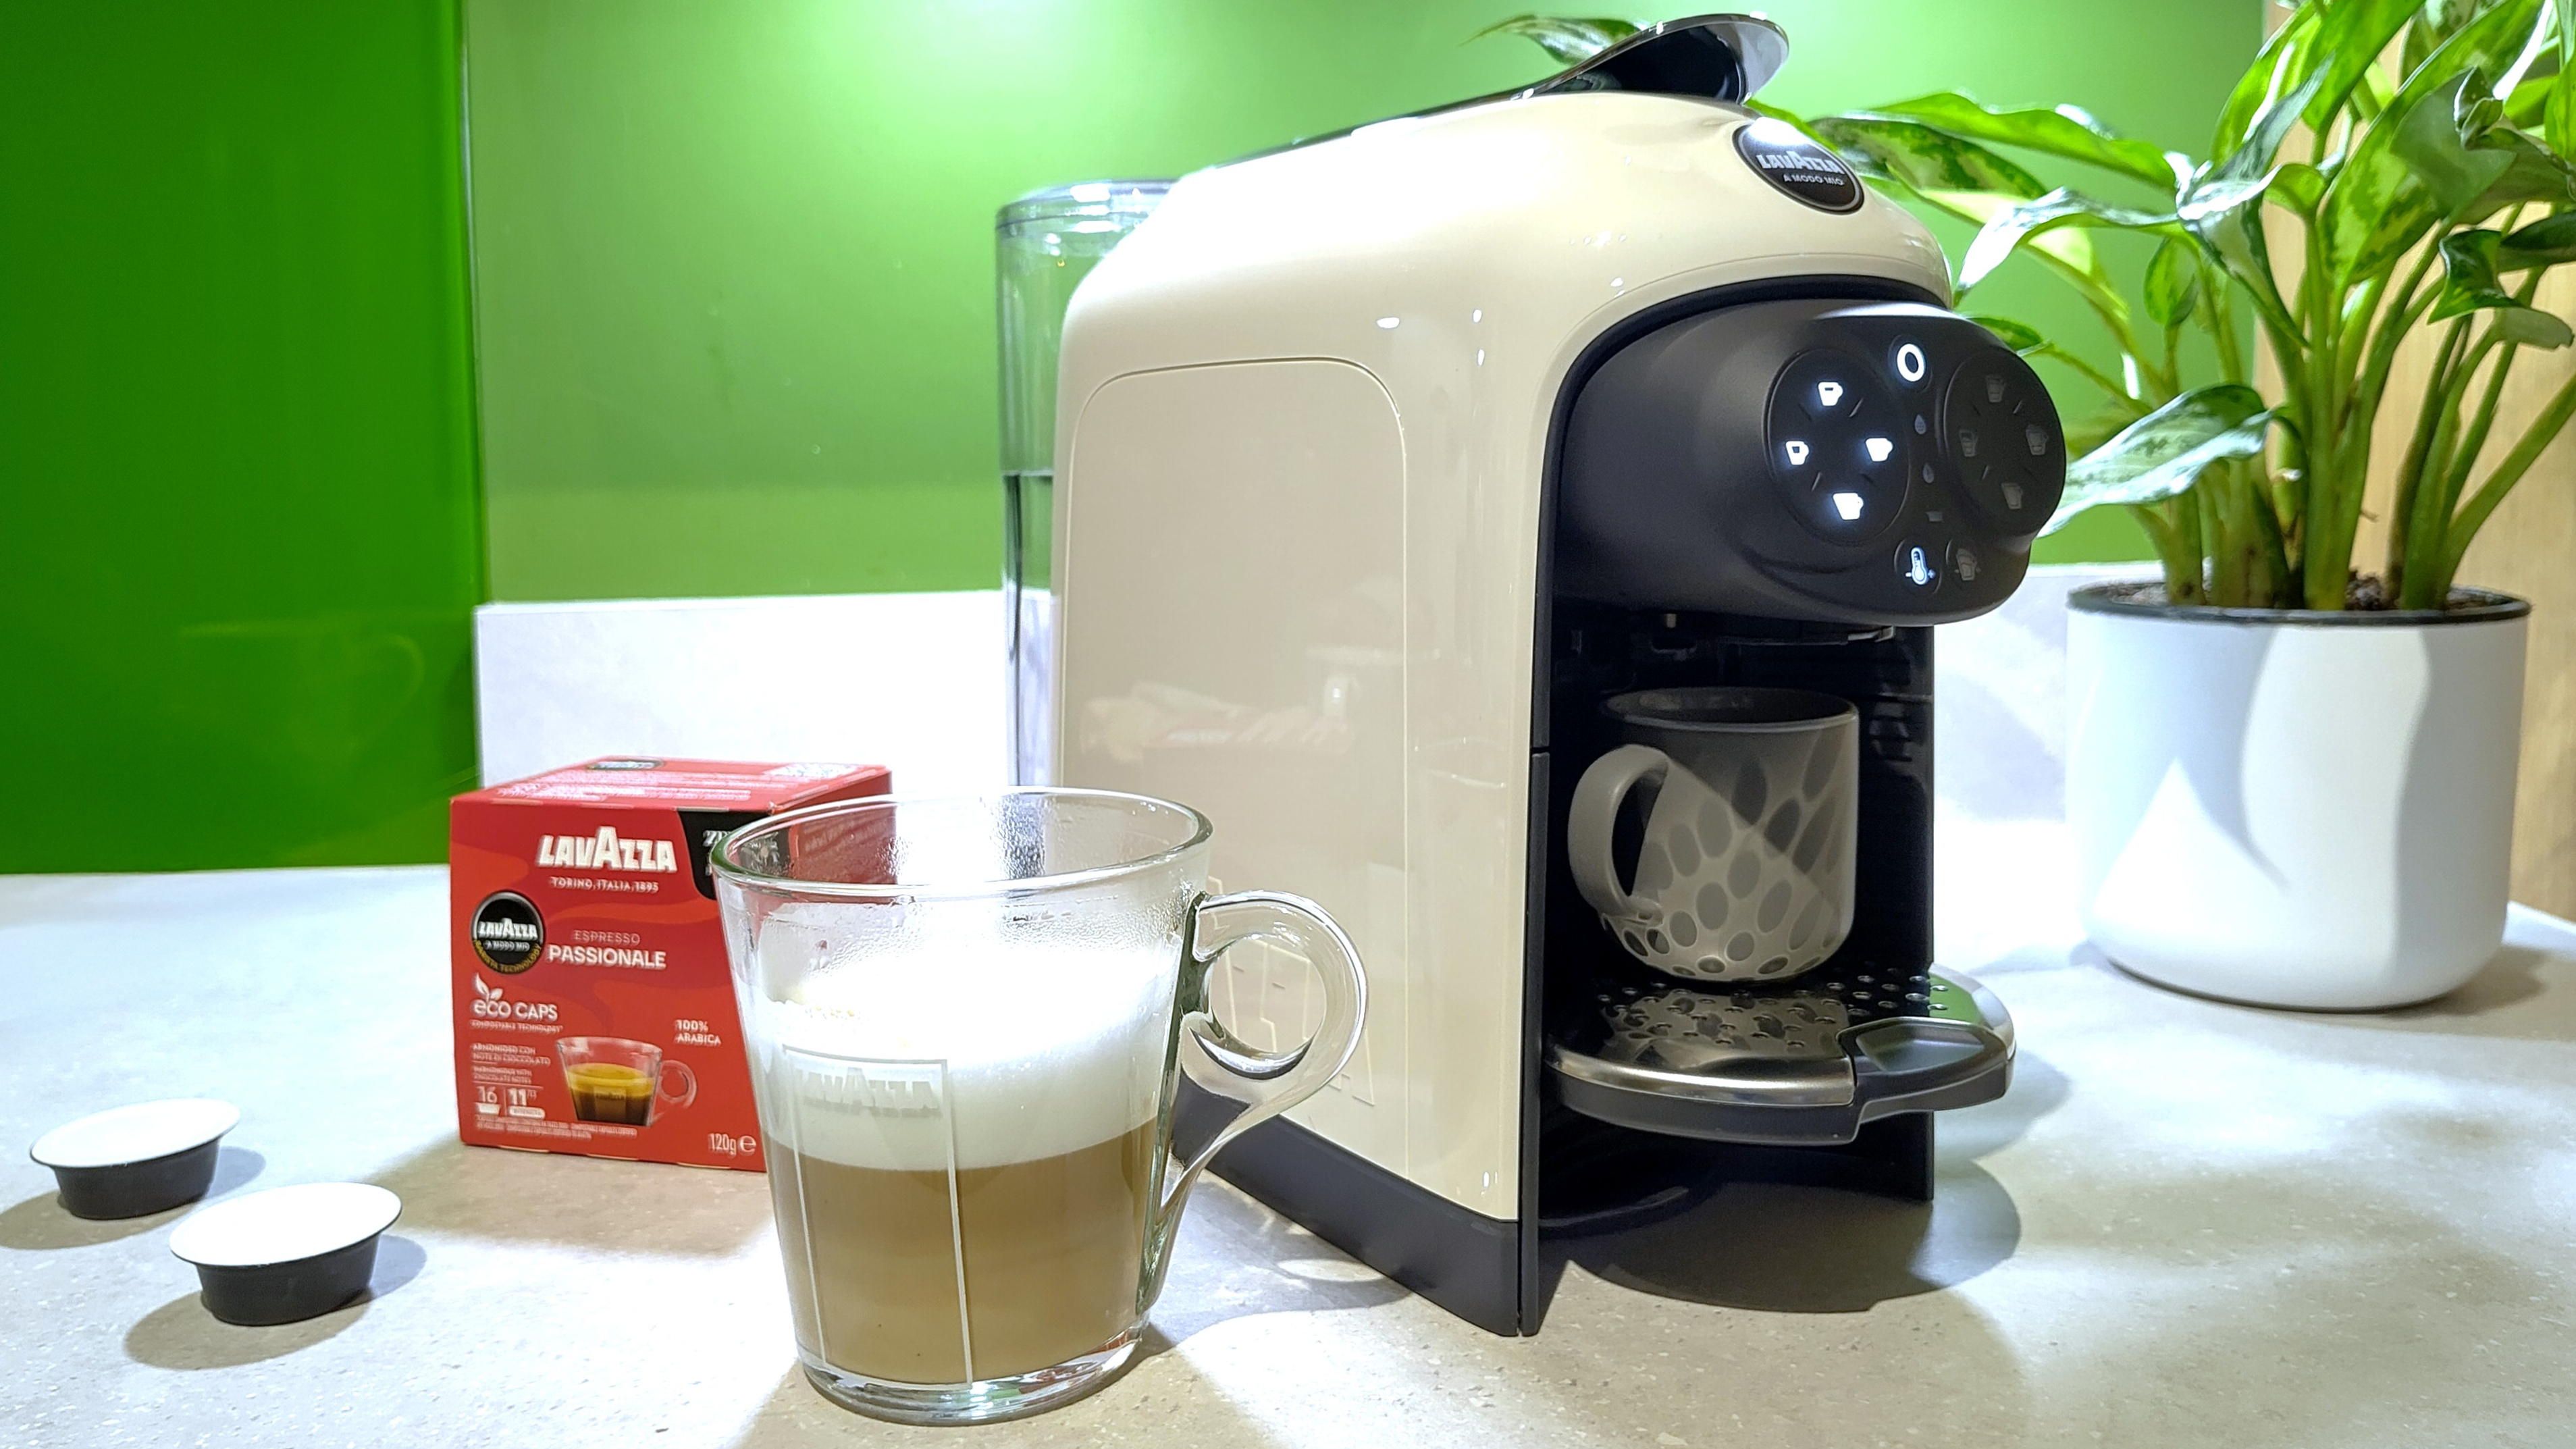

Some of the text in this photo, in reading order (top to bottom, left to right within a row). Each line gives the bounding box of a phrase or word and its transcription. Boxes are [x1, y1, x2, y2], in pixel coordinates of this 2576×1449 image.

[1756, 151, 1845, 174] LAVAZZA
[1783, 174, 1844, 186] A MODO MIO
[537, 826, 677, 873] LAVAZZA
[477, 918, 538, 941] LAVAZZA
[574, 930, 640, 945] ESPRESSO
[548, 945, 666, 970] PASSIONALE
[513, 1002, 558, 1022] CAPS
[676, 1020, 708, 1032] 100%
[676, 1032, 721, 1046] ARABICA
[477, 1086, 498, 1103] 16
[708, 1132, 737, 1158] 120g
